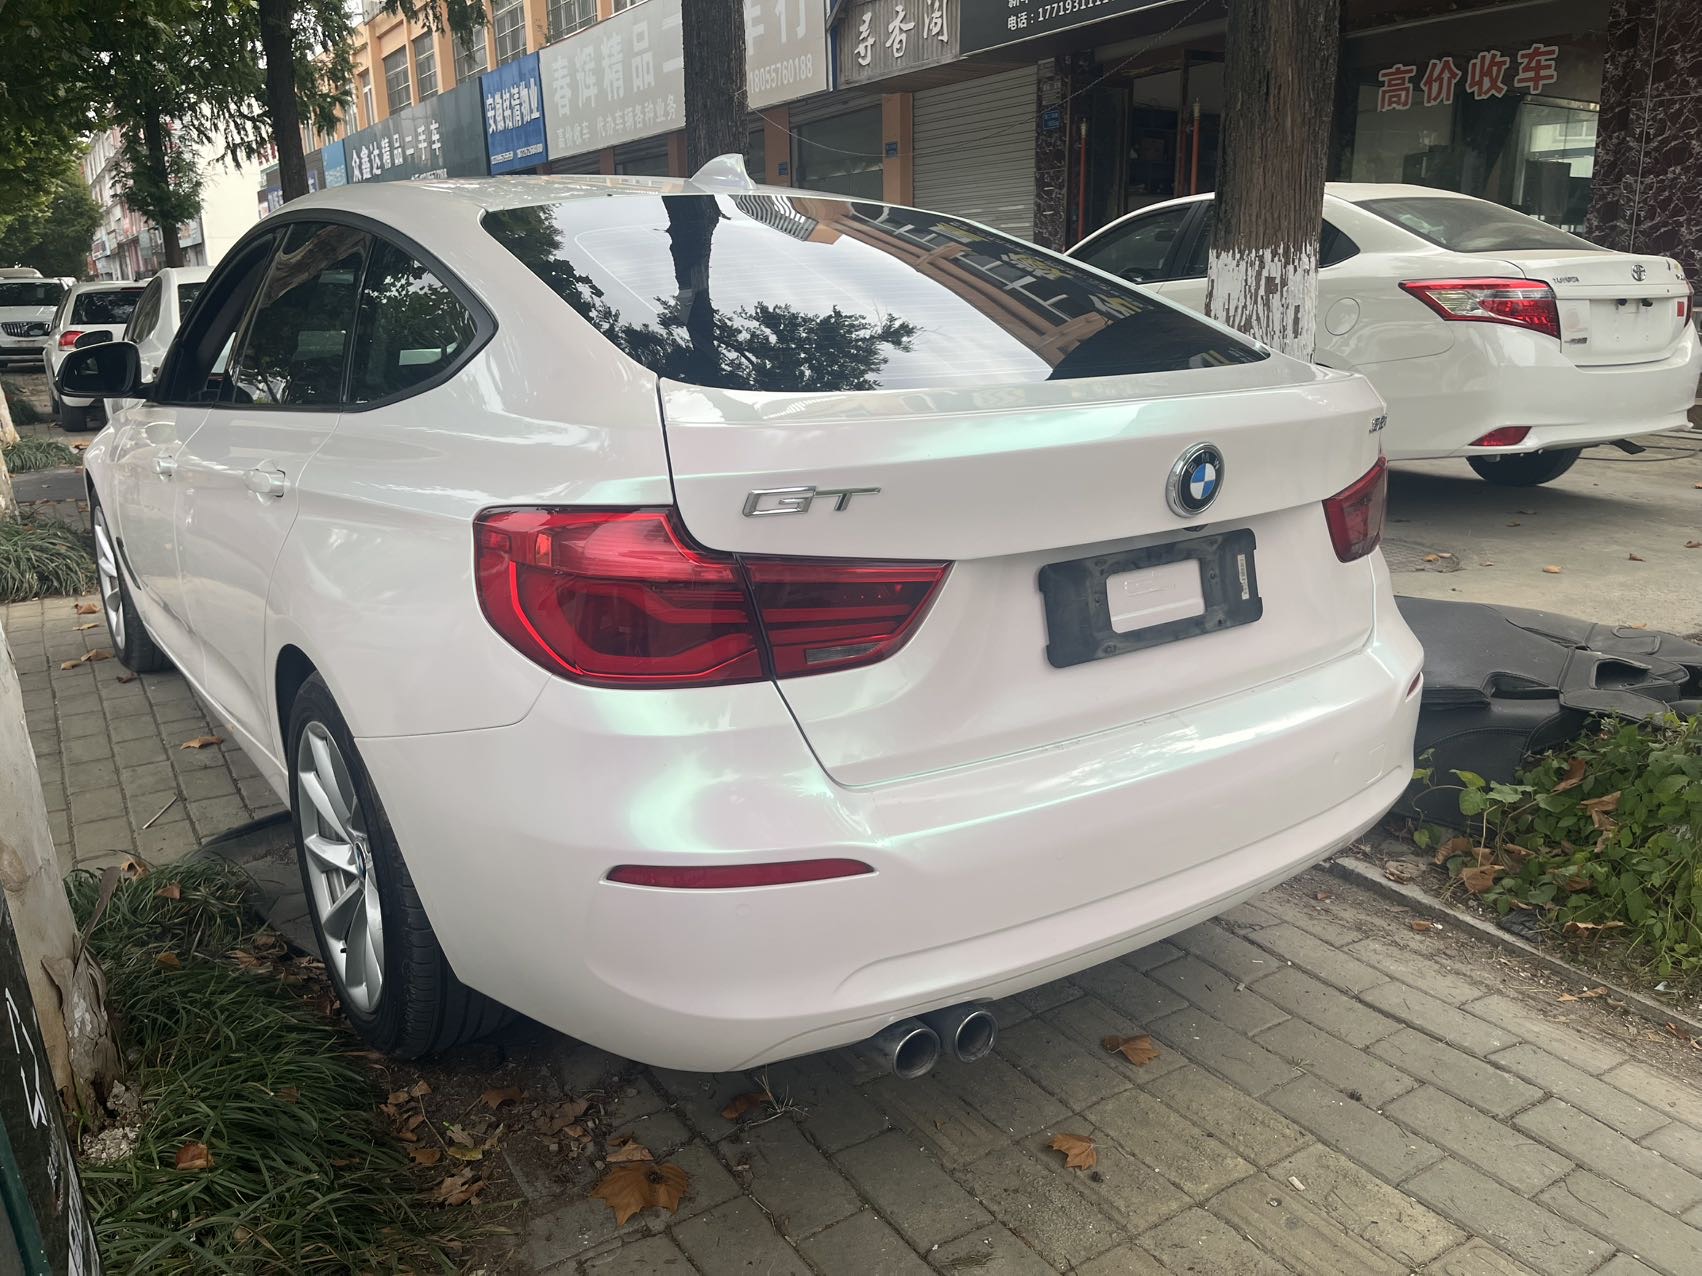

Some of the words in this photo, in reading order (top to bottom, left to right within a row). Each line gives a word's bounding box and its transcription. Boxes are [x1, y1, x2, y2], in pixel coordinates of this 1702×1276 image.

[751, 54, 812, 93] 18055760188
[1378, 45, 1558, 112] 高价收车
[1187, 452, 1221, 474] BMW
[743, 486, 881, 517] GT
